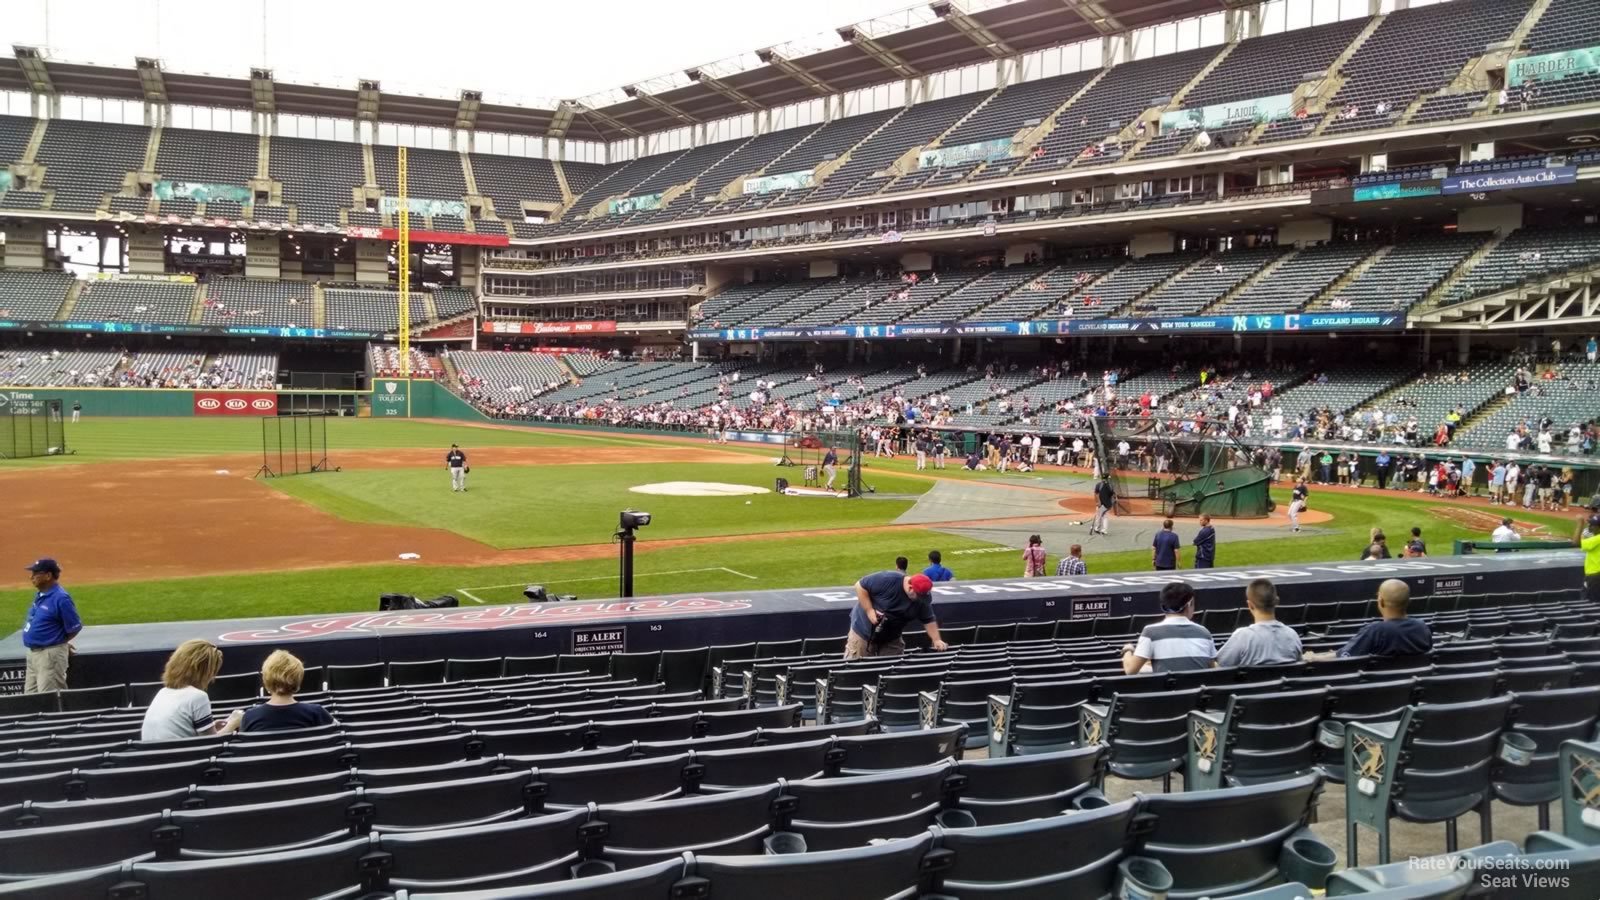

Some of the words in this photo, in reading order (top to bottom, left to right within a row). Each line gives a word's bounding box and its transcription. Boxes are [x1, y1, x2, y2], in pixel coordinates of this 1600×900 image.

[1516, 57, 1575, 77] HARDER
[1459, 180, 1475, 189] The
[1475, 176, 1515, 188] Collection
[1515, 174, 1535, 184] Auto
[1535, 171, 1556, 182] Club
[122, 324, 133, 332] VS
[140, 324, 151, 332] C
[533, 322, 570, 333] Budweiser
[1036, 323, 1048, 333] VS
[1058, 321, 1069, 335] C
[1257, 317, 1272, 329] VS
[1284, 314, 1299, 331] C
[1312, 317, 1350, 325] CLEVELAND
[314, 329, 324, 338] C
[738, 331, 745, 339] VS
[751, 329, 758, 340] C
[869, 327, 878, 336] VS
[885, 325, 895, 337] C
[201, 400, 217, 408] KIA
[228, 400, 244, 408] KIA
[802, 569, 1313, 602] ETABLISHED
[1085, 602, 1108, 610] ALERT
[218, 597, 752, 642] Indians
[576, 634, 589, 643] BE
[591, 632, 622, 642] ALERT
